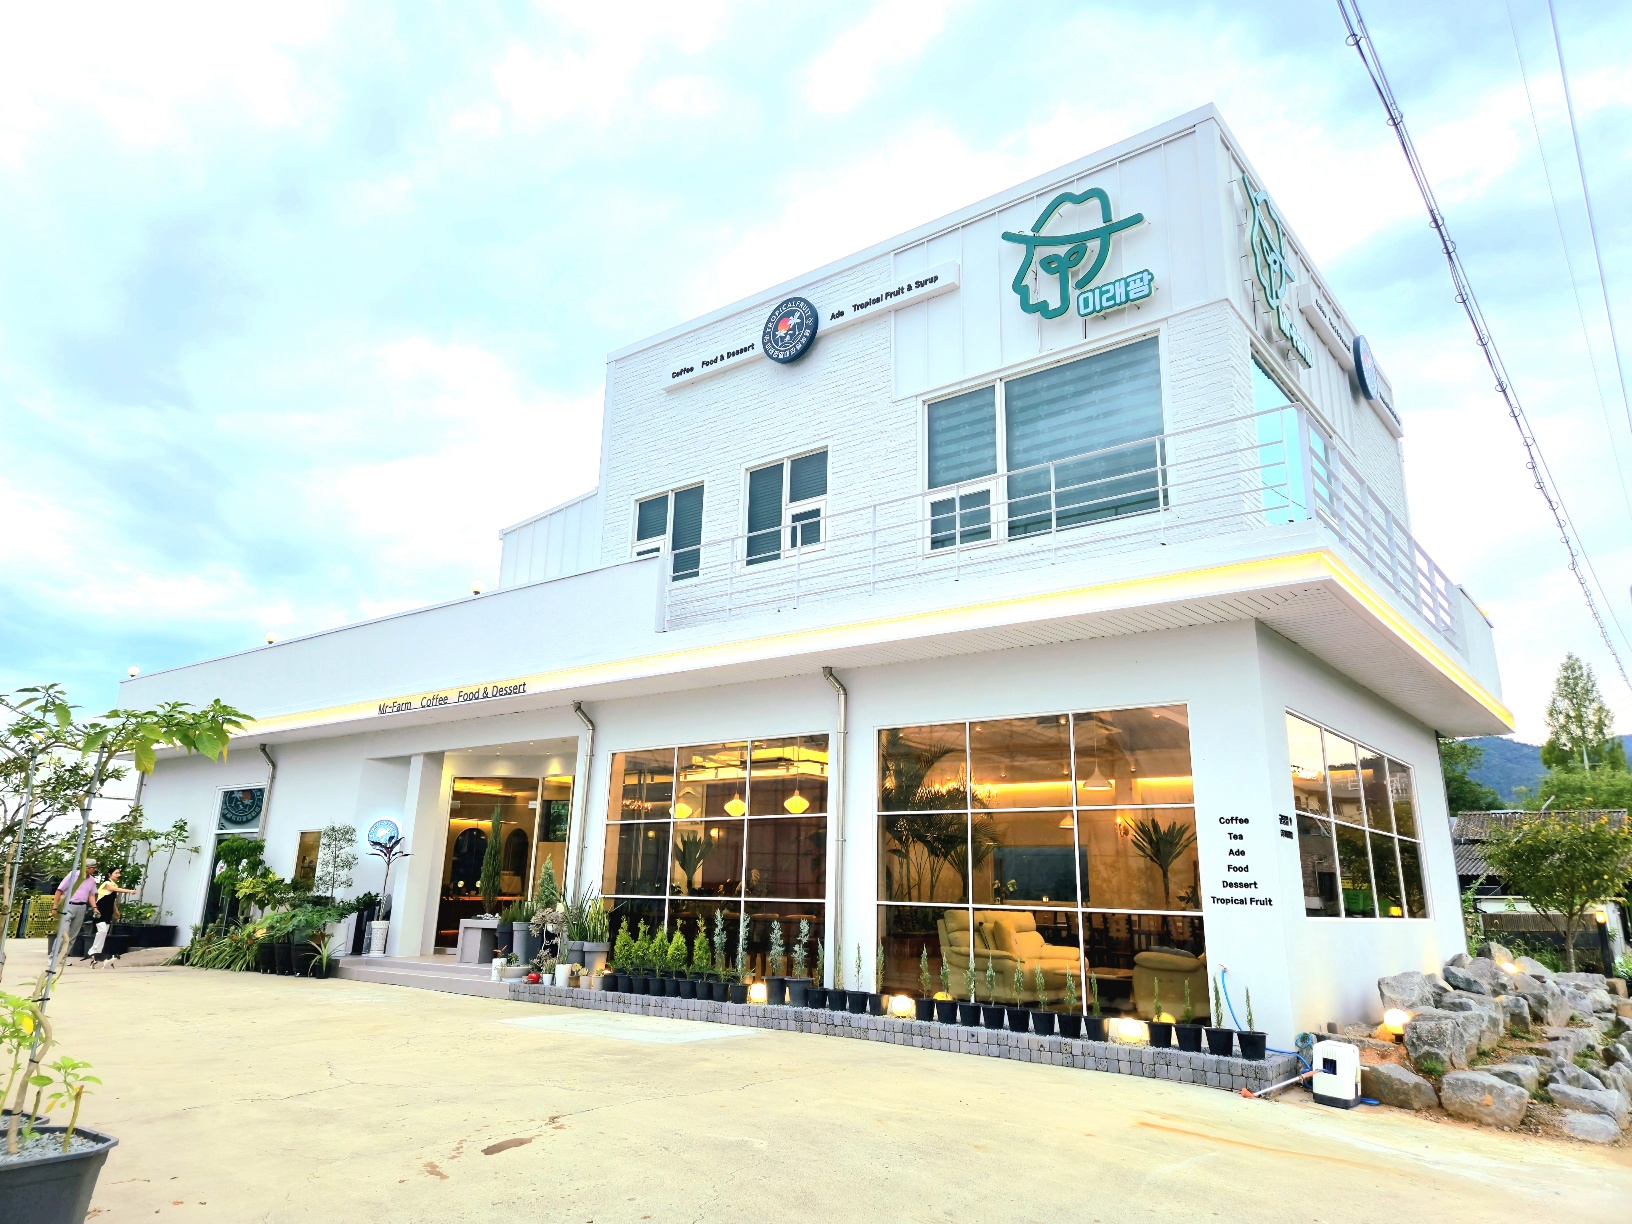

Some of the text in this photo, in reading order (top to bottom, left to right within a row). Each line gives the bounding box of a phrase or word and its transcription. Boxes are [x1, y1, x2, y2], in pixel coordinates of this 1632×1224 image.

[1078, 271, 1152, 315] 미래팜
[830, 275, 939, 321] Ade Tropical Fruit & Syrup
[671, 366, 695, 379] Coffee
[701, 356, 719, 369] Food
[719, 354, 725, 362] &
[727, 342, 755, 359] Dessert
[420, 694, 449, 709] Coffee
[457, 688, 480, 703] Food
[482, 687, 489, 698] &
[491, 681, 527, 697] Dessert
[1219, 816, 1250, 825] Coffee
[1227, 832, 1244, 841] Tea
[1228, 848, 1246, 857] Ade
[1227, 864, 1249, 873] Food
[1222, 880, 1258, 889] Dessert
[1211, 896, 1273, 906] Tropical Fruit
